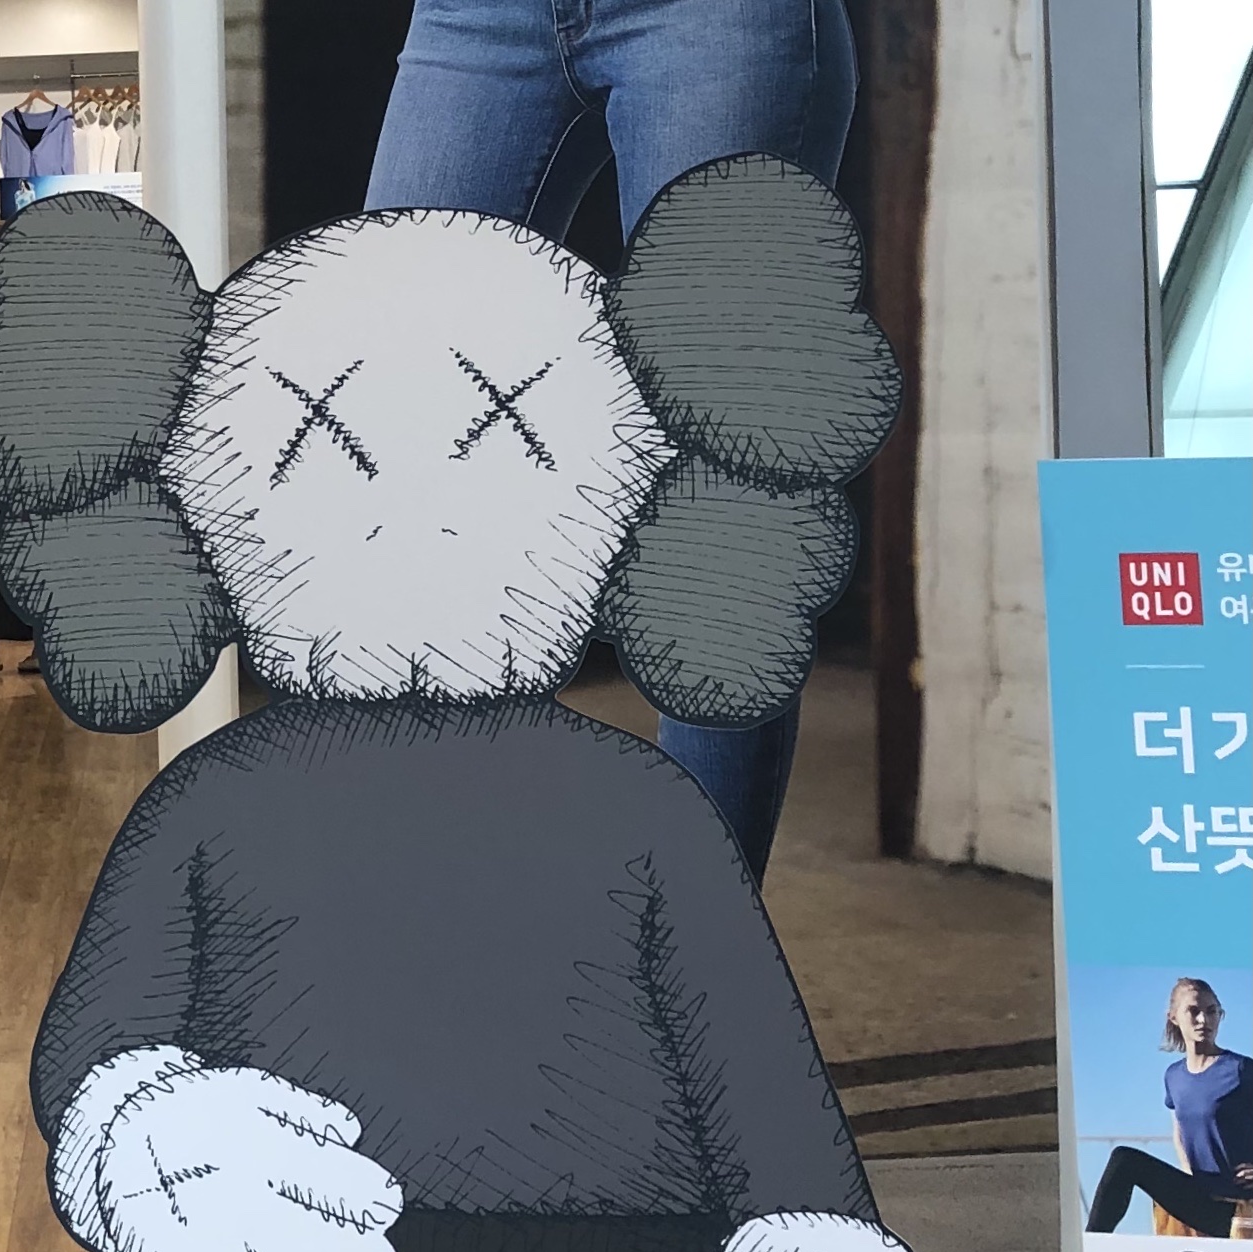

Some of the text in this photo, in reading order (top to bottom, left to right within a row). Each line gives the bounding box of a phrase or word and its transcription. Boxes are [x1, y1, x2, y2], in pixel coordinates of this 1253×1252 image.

[1129, 561, 1186, 587] UNI
[1216, 552, 1253, 582] 유
[1131, 591, 1194, 621] QLO
[1220, 594, 1253, 625] 여
